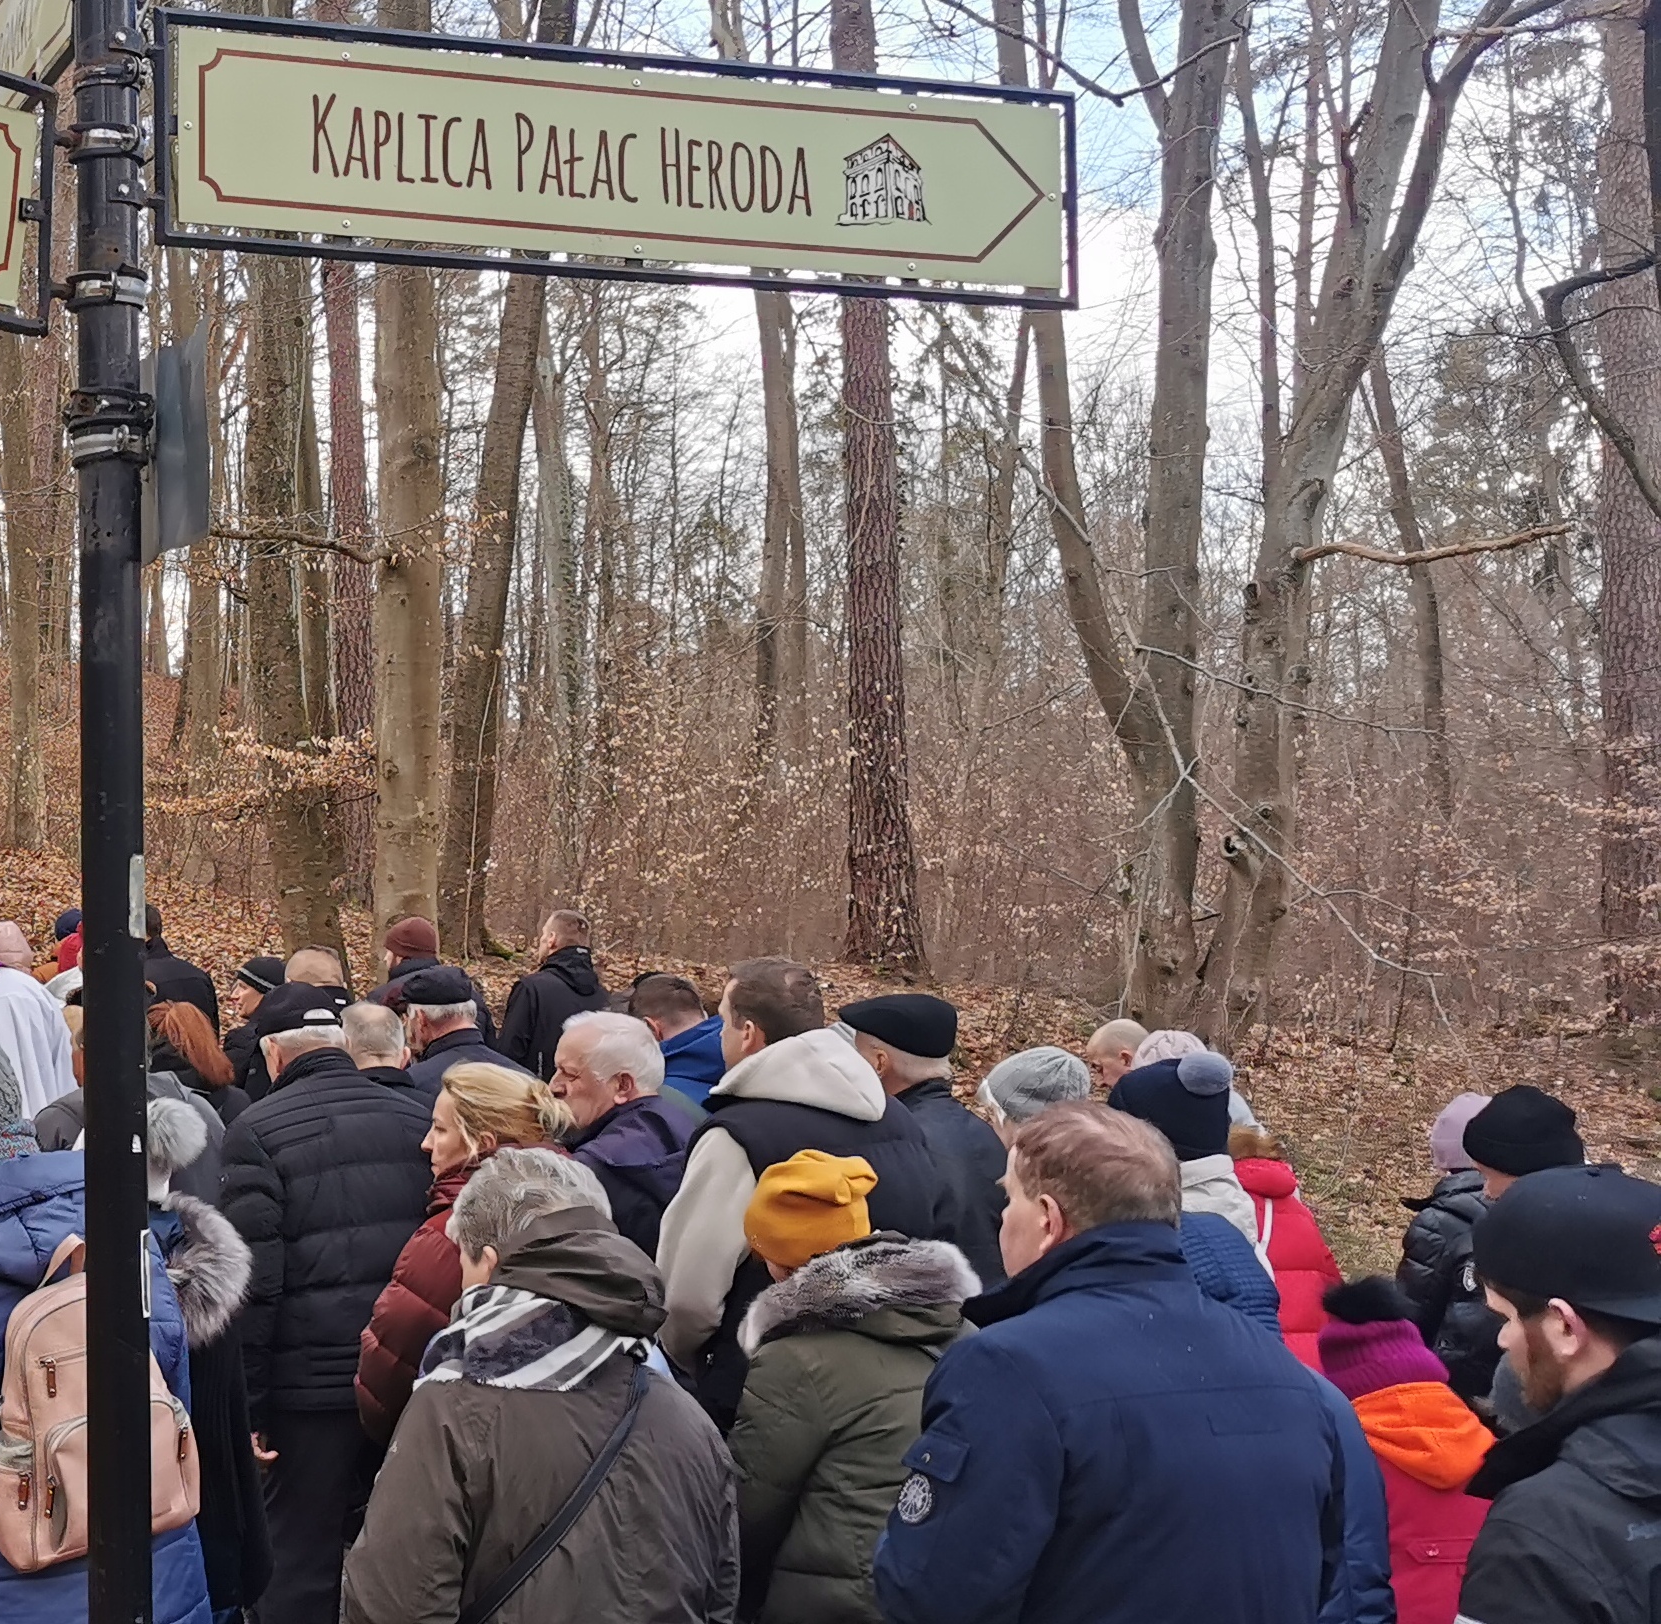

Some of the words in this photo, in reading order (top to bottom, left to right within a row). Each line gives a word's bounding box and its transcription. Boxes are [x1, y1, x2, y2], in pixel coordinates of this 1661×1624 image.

[312, 93, 494, 192] KAPLICA
[514, 112, 640, 205] PAŁAC
[660, 126, 813, 218] HERODA
